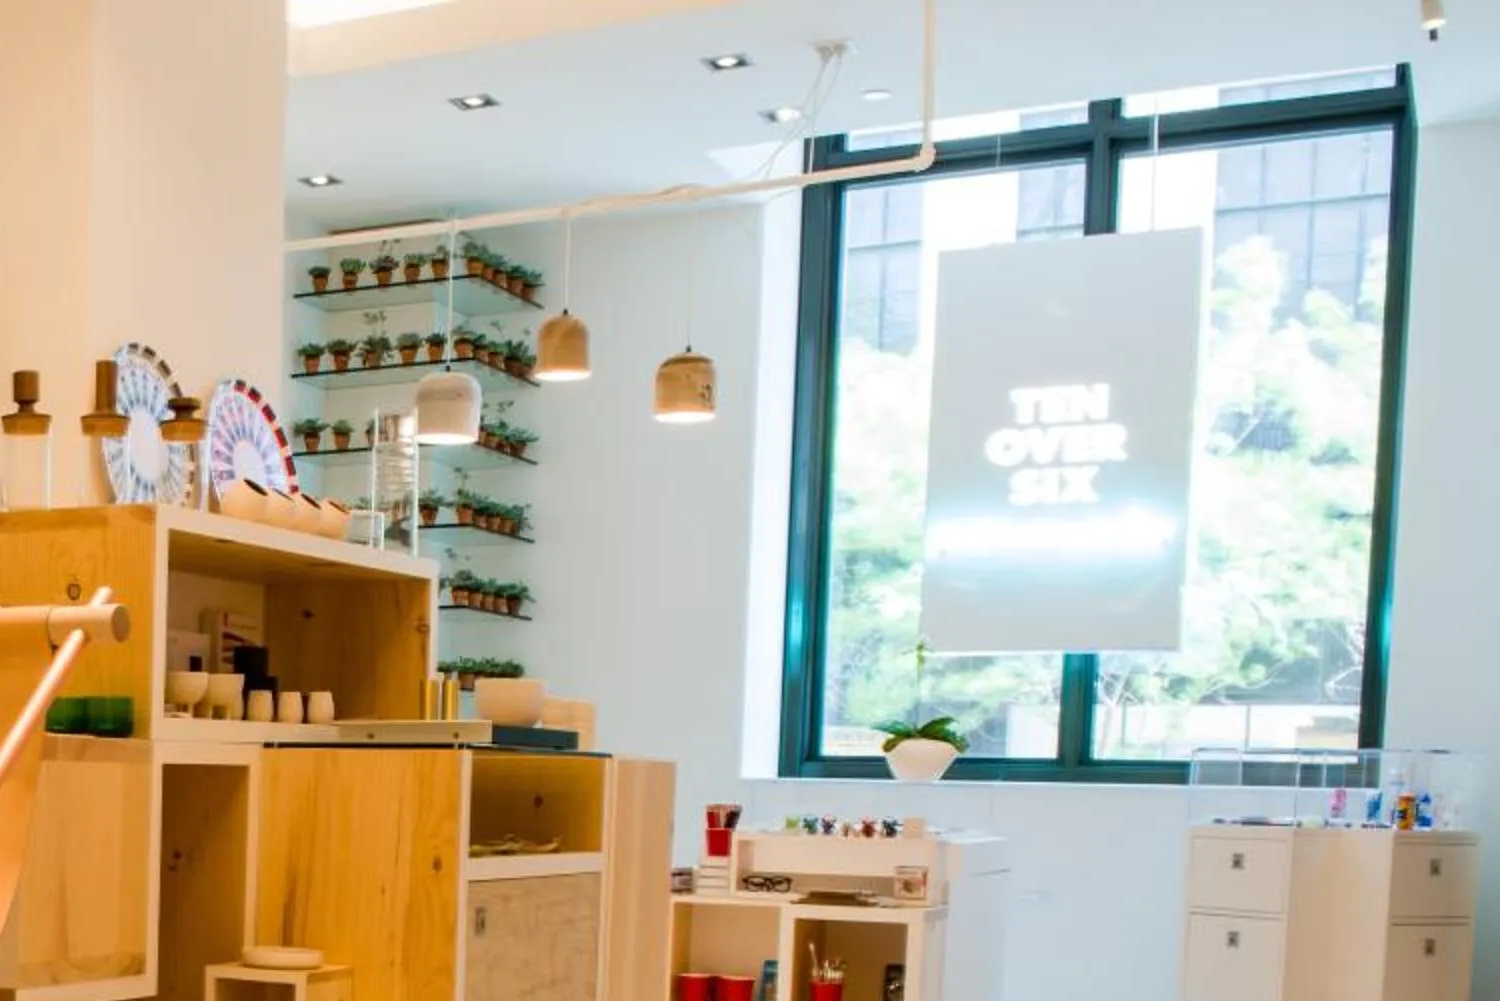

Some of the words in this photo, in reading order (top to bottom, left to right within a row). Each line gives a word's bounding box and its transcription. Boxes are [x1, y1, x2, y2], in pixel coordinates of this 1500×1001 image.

[1008, 382, 1110, 425] TEN
[983, 422, 1129, 467] OVER
[1007, 464, 1101, 506] SIX
